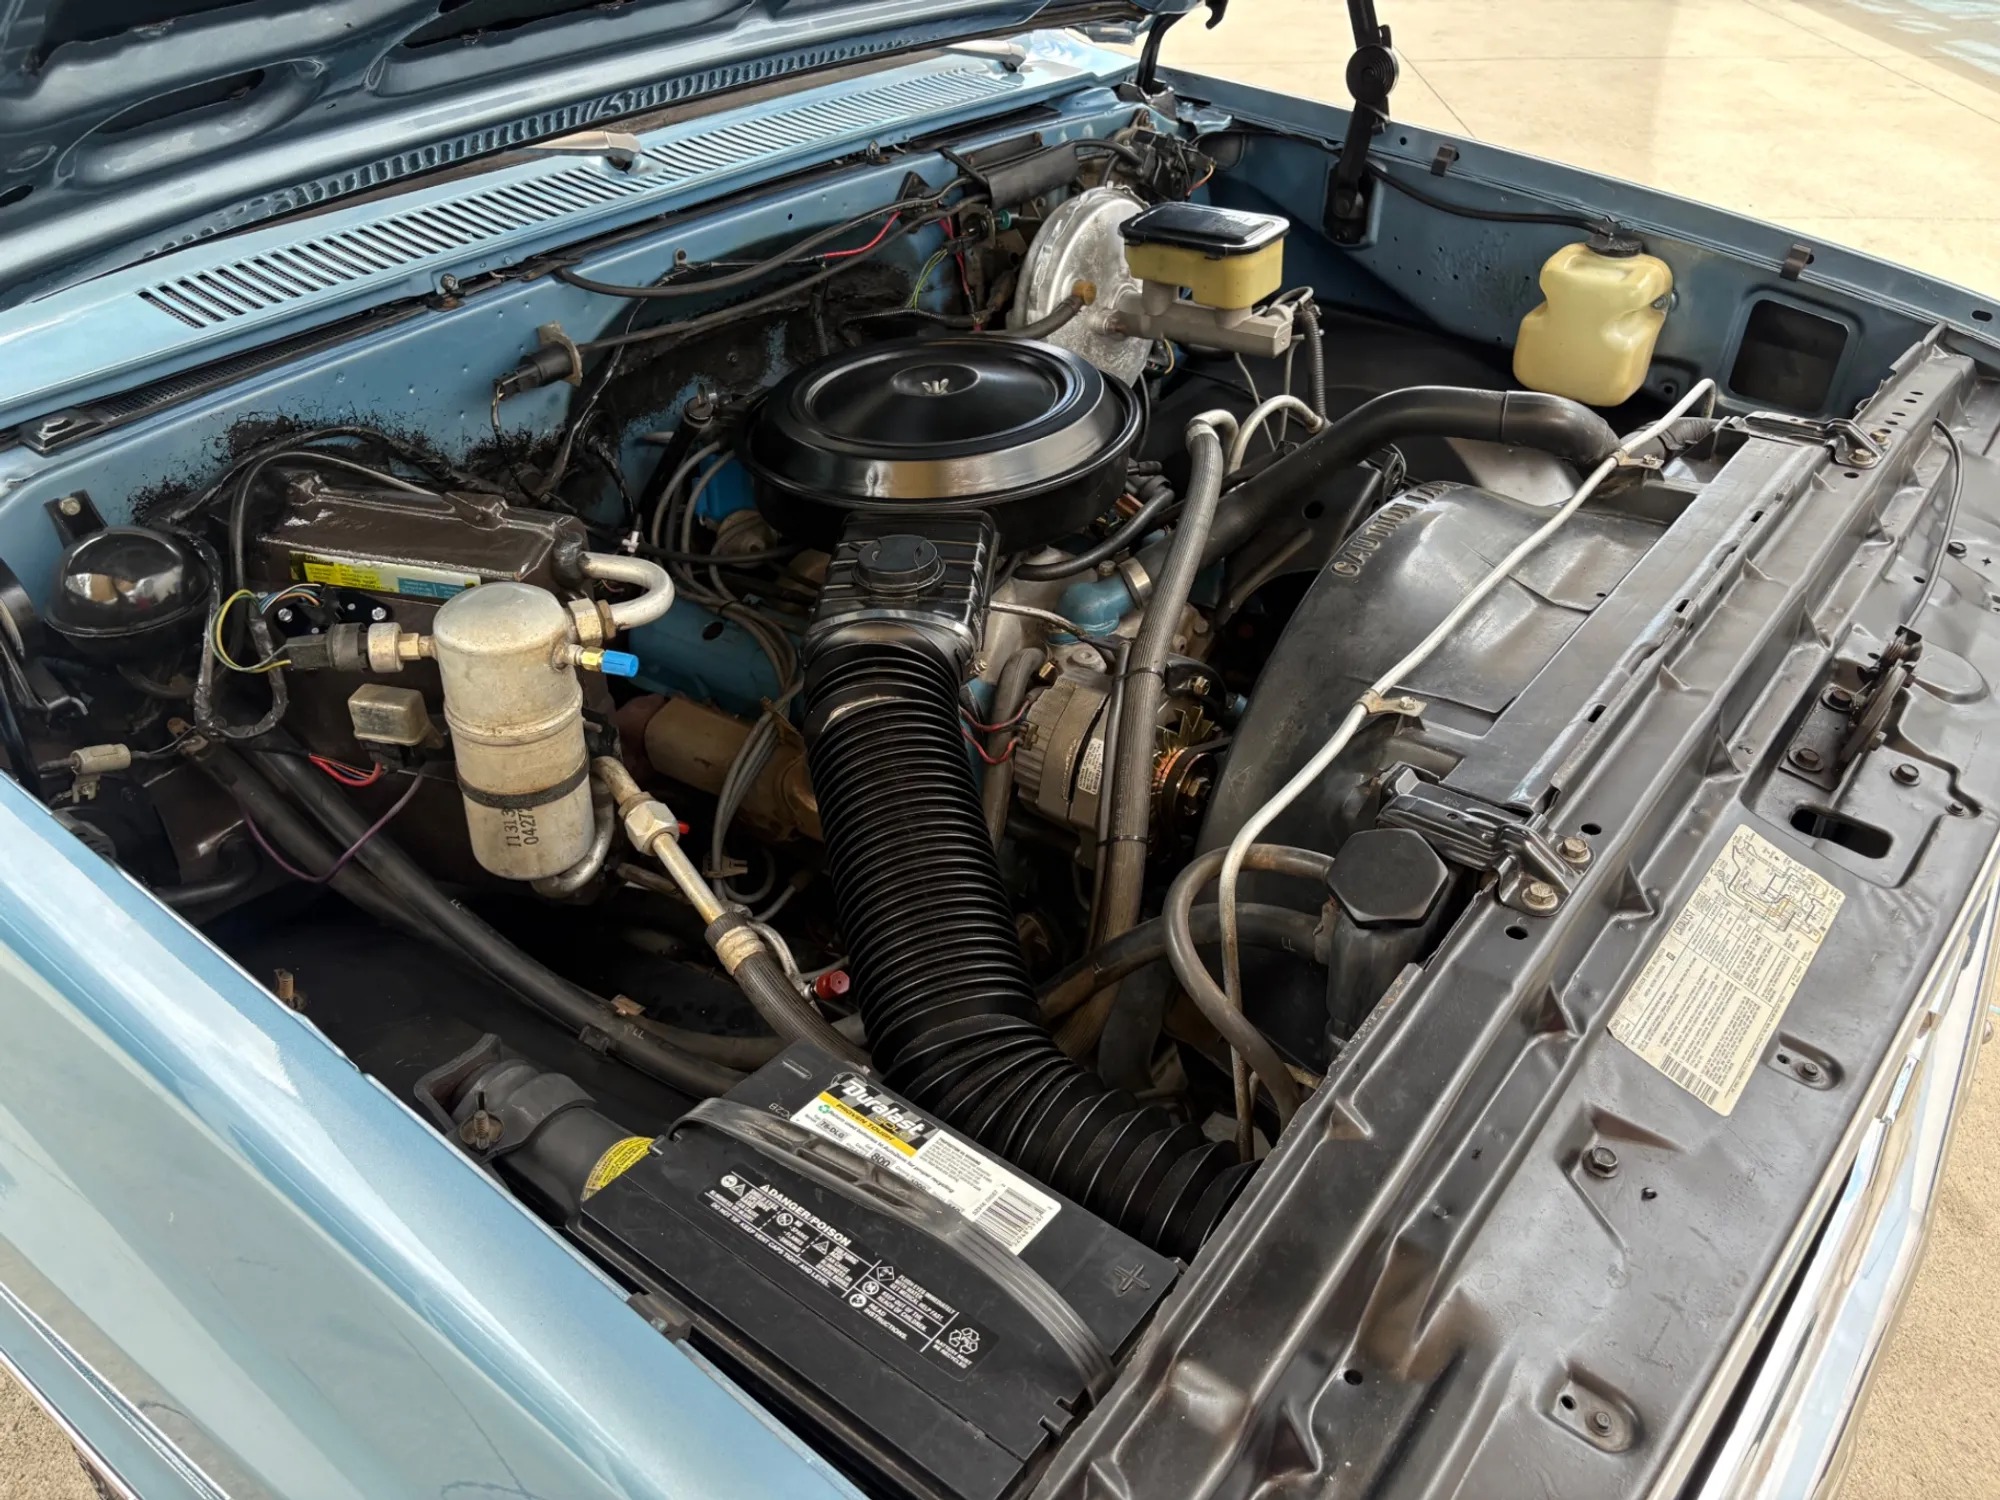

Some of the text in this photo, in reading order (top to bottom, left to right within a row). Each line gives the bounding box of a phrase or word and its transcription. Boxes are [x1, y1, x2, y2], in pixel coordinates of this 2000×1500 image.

[841, 1078, 926, 1136] Duralast
[836, 1103, 868, 1124] PROVEN
[867, 1122, 895, 1141] TOUGH
[875, 1115, 911, 1139] GOLD
[870, 1152, 891, 1168] 800
[768, 1188, 852, 1247] DANGER/POISON
[710, 1201, 721, 1210] DO
[719, 1208, 733, 1219] NOT
[740, 1222, 756, 1234] KEEP
[754, 1231, 770, 1244] VENT
[768, 1241, 785, 1255] CAPS
[783, 1252, 801, 1266] TIGHT
[799, 1263, 813, 1274] AND
[868, 1302, 887, 1317] READ
[876, 1295, 895, 1310] REACH
[893, 1306, 903, 1314] OF
[881, 1290, 924, 1320] KEEP OUT OF THE
[889, 1282, 901, 1292] GET
[918, 1301, 932, 1312] HELP
[934, 1339, 959, 1356] BATTERY
[957, 1353, 973, 1366] MUST
[940, 1348, 967, 1369] RECYCLED
